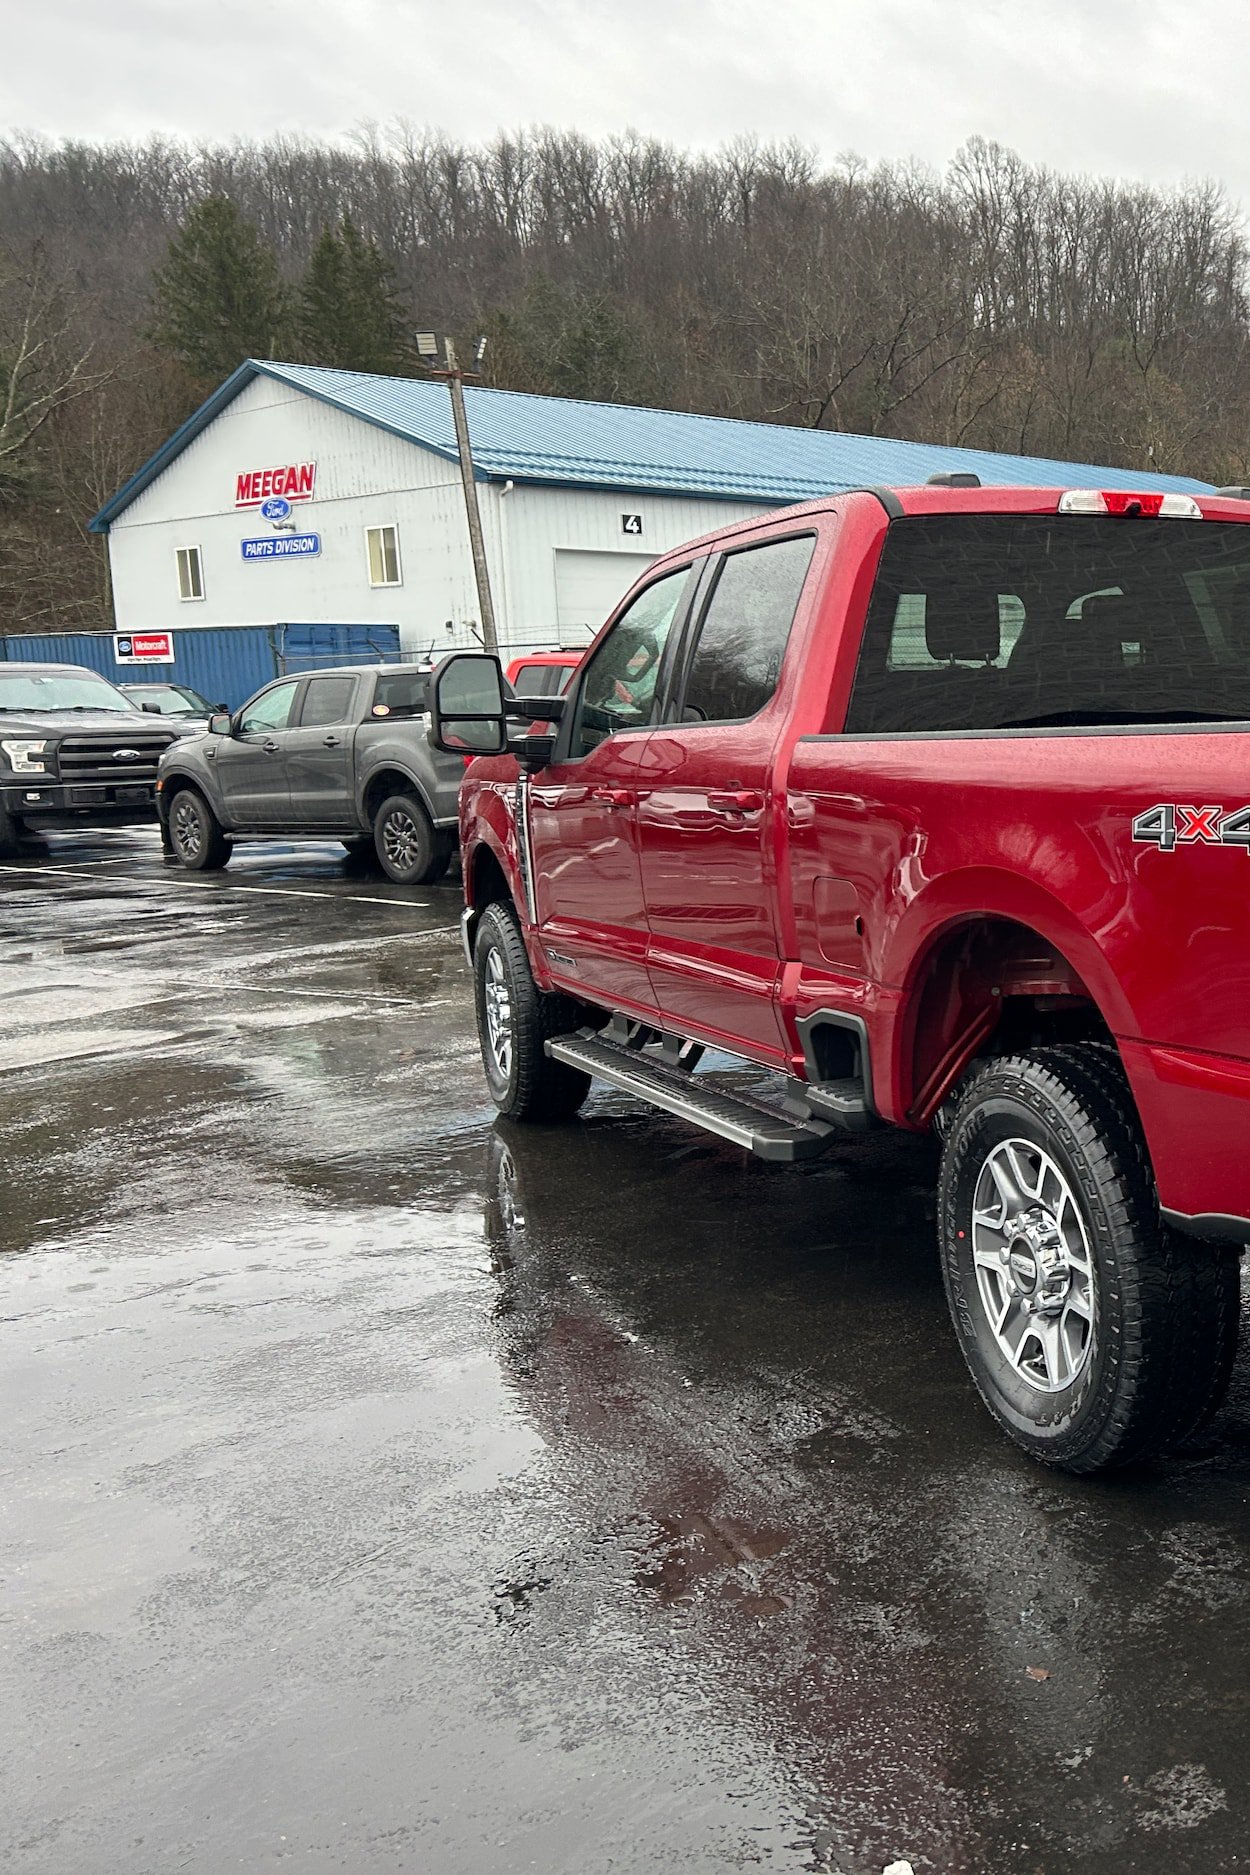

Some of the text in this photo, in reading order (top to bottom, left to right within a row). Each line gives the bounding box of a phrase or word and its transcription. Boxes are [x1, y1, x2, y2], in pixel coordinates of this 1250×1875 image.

[235, 463, 315, 501] MEEGAN
[266, 501, 285, 517] Ford
[625, 515, 640, 533] 4
[245, 536, 315, 557] PARTS DIVISION
[135, 639, 167, 651] Motorcraft
